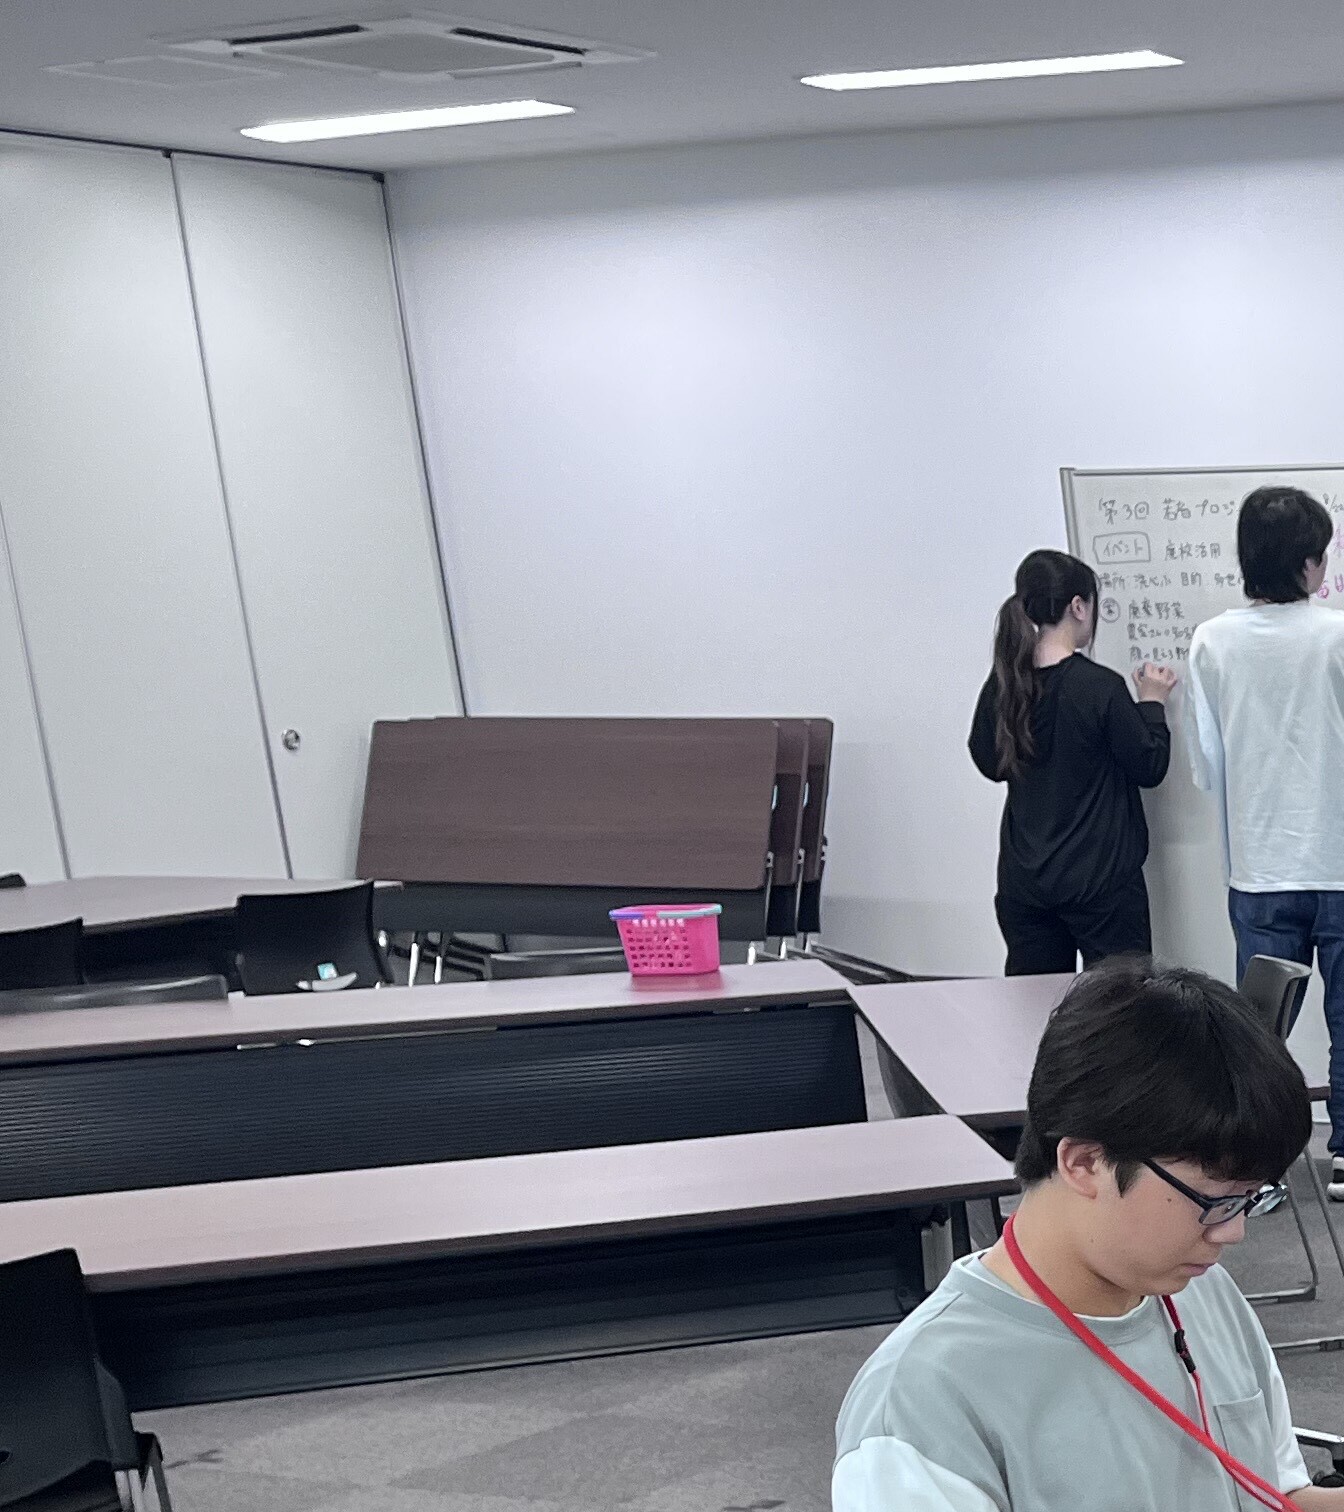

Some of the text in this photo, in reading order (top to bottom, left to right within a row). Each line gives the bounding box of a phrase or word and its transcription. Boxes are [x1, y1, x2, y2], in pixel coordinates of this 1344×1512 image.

[1099, 497, 1150, 525] 第3回
[1103, 537, 1143, 558] イベント
[1180, 571, 1202, 587] 目的
